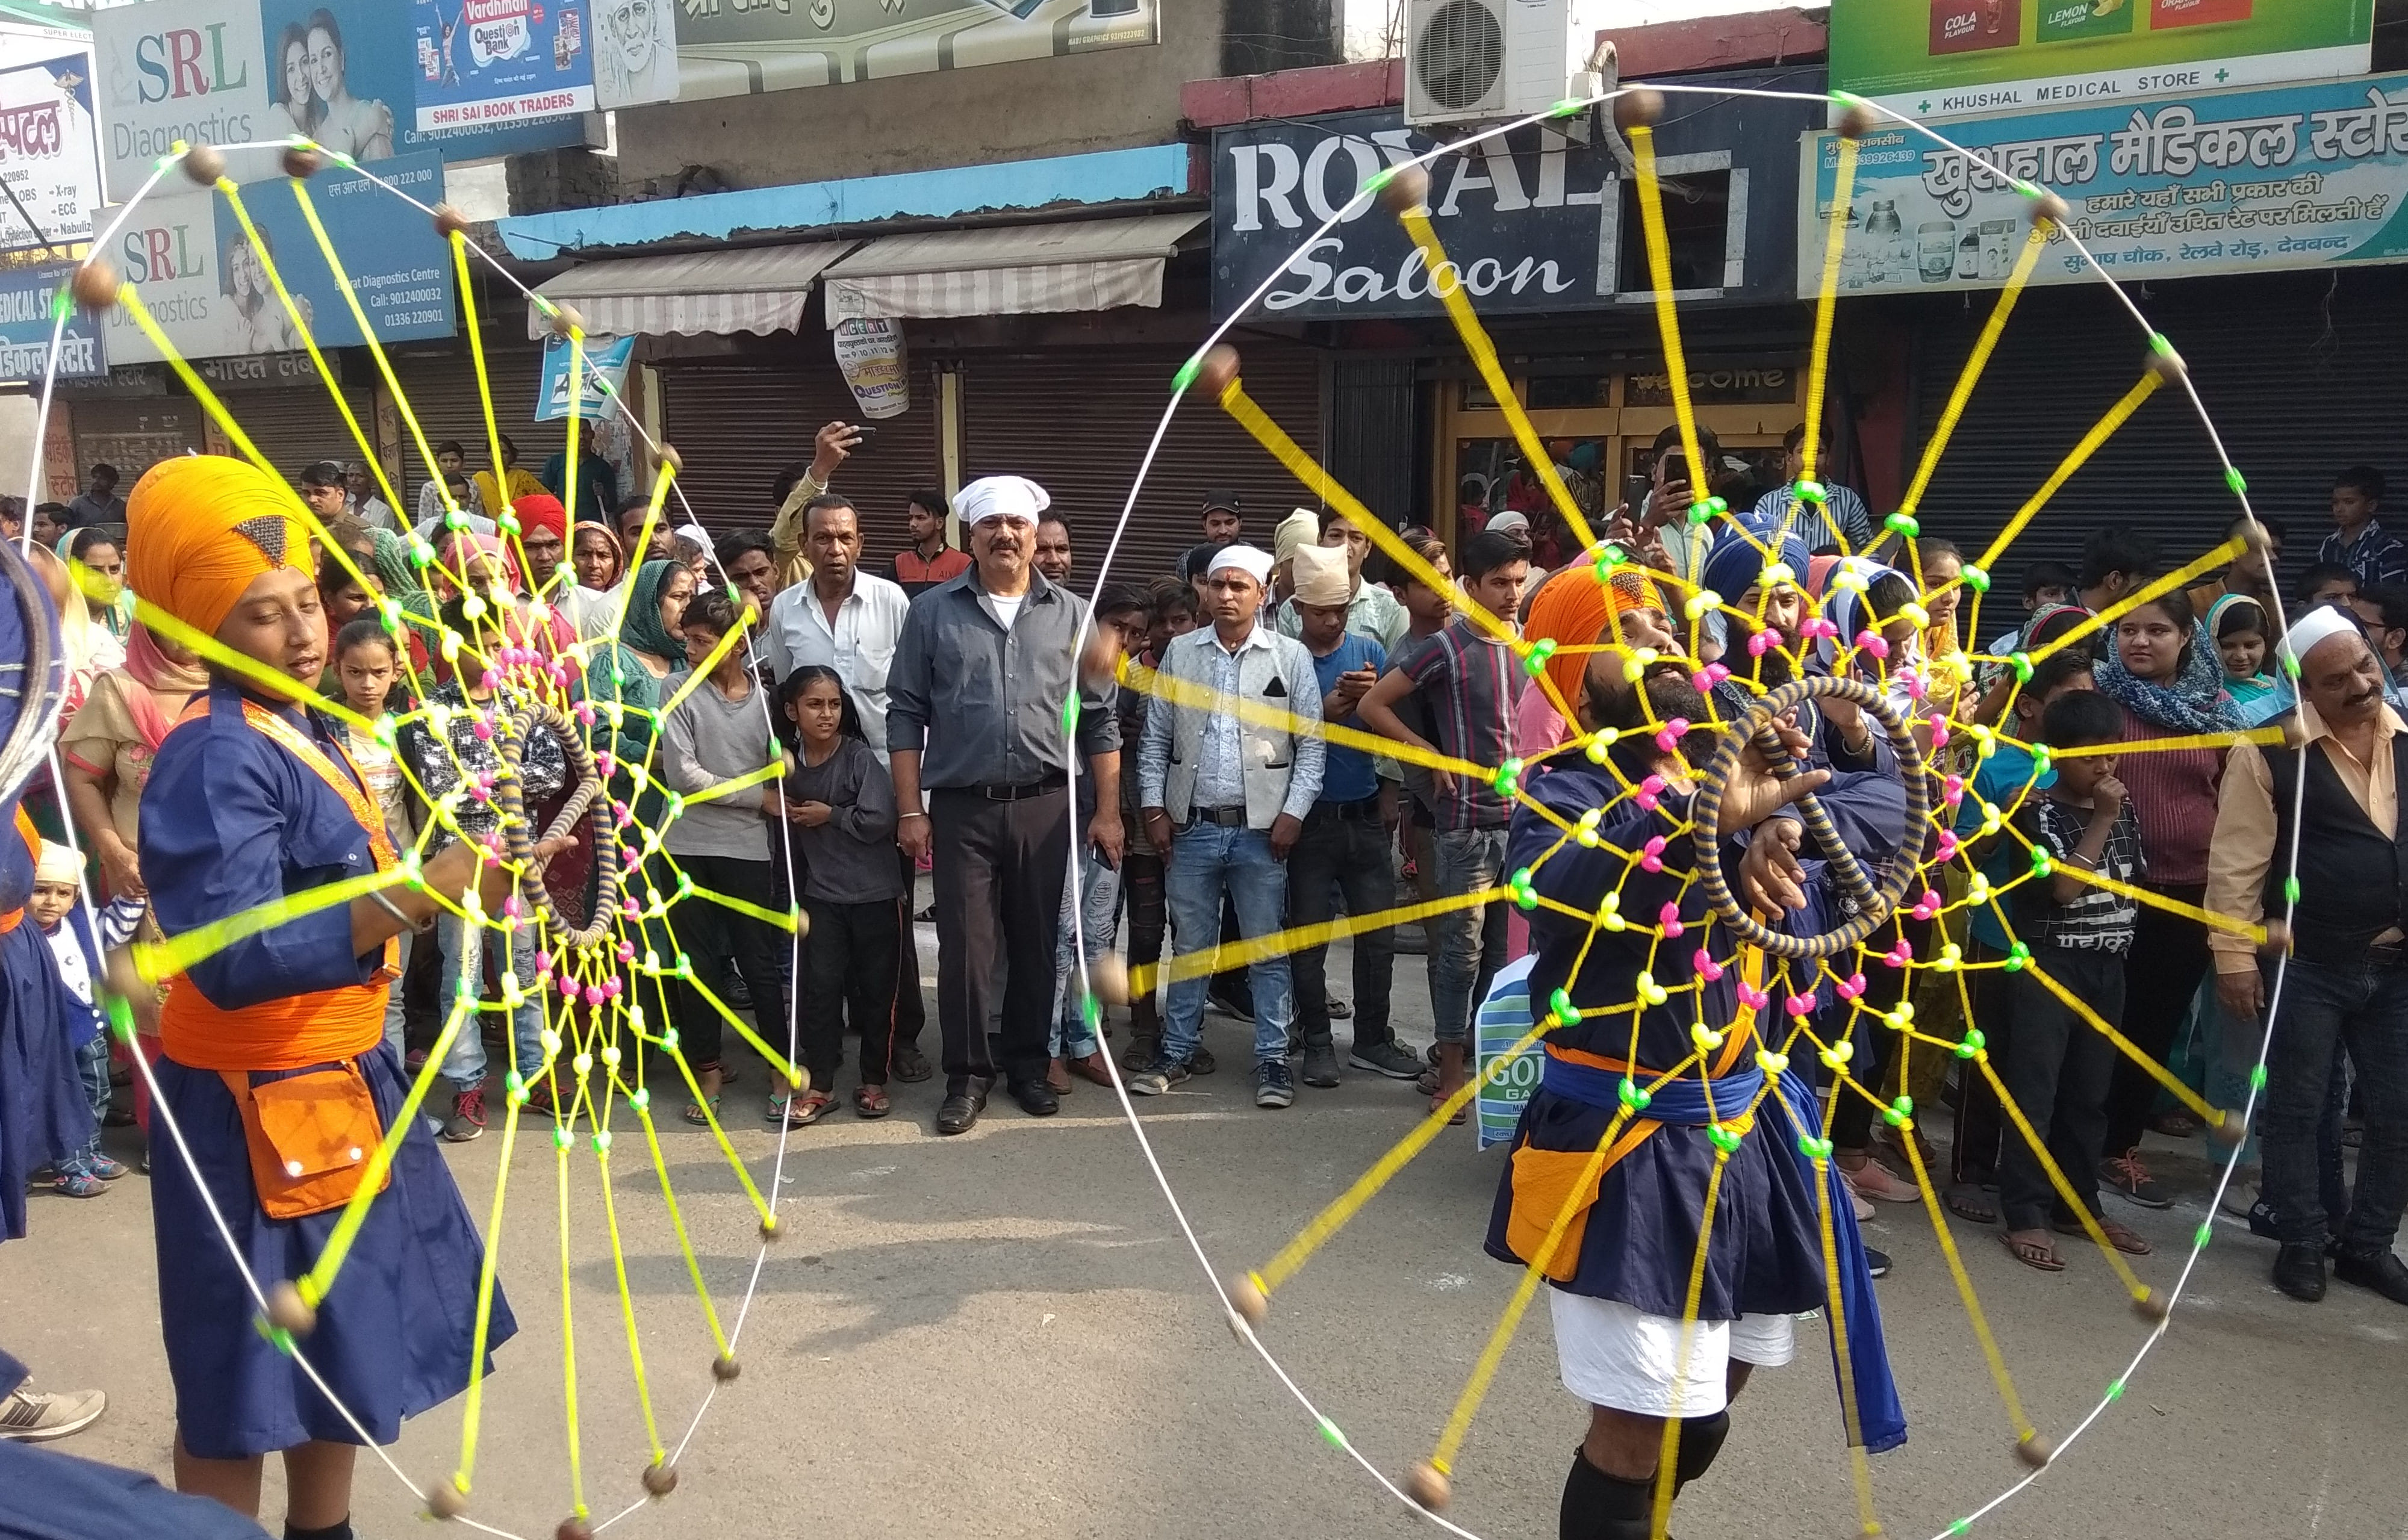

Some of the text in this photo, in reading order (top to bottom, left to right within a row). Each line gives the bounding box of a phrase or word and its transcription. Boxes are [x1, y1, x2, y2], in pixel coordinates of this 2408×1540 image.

[467, 0, 528, 20] Vardhman
[1945, 11, 1977, 31] COLA
[2048, 2, 2089, 25] LEMON
[43, 28, 67, 37] SUPER
[1944, 24, 1976, 39] FLAVOUR
[2061, 15, 2086, 28] FLAVOUR
[485, 38, 510, 56] Bank
[1082, 33, 1109, 44] GRAPHICS
[135, 22, 247, 105] SRL
[1943, 70, 2201, 111] KHUSHAL MEDICAL STORE
[432, 92, 574, 124] SHRI SAI BOOK TRADERS
[113, 107, 253, 160] Diagnostics
[1921, 133, 2105, 220] खुशहाल
[2109, 104, 2304, 176] मैडिकल
[400, 171, 415, 185] 222
[416, 168, 432, 182] 000
[1229, 128, 1615, 232] ROYAL
[19, 187, 37, 203] OBS
[2085, 171, 2324, 213] हमारे यहाँ सभी प्रकार की
[58, 201, 77, 217] ECG
[2170, 208, 2225, 233] उचित
[2227, 206, 2257, 229] रेट
[2258, 208, 2288, 226] पर
[2291, 195, 2363, 225] मिलती
[2364, 193, 2391, 220] हैं
[123, 224, 204, 285] SRL
[2179, 240, 2224, 260] रेलवे
[2277, 235, 2351, 254] देवबन्द
[362, 270, 411, 290] Diagnostics
[411, 268, 440, 282] Centre
[1263, 237, 1576, 311] Saloon
[370, 287, 442, 307] Call: 9012400032
[111, 290, 208, 335] Dianostics
[384, 309, 444, 328] 01336 220901
[839, 321, 887, 335] NCERT
[859, 349, 868, 358] 10
[871, 347, 879, 355] 11
[1633, 368, 1785, 390] wecome
